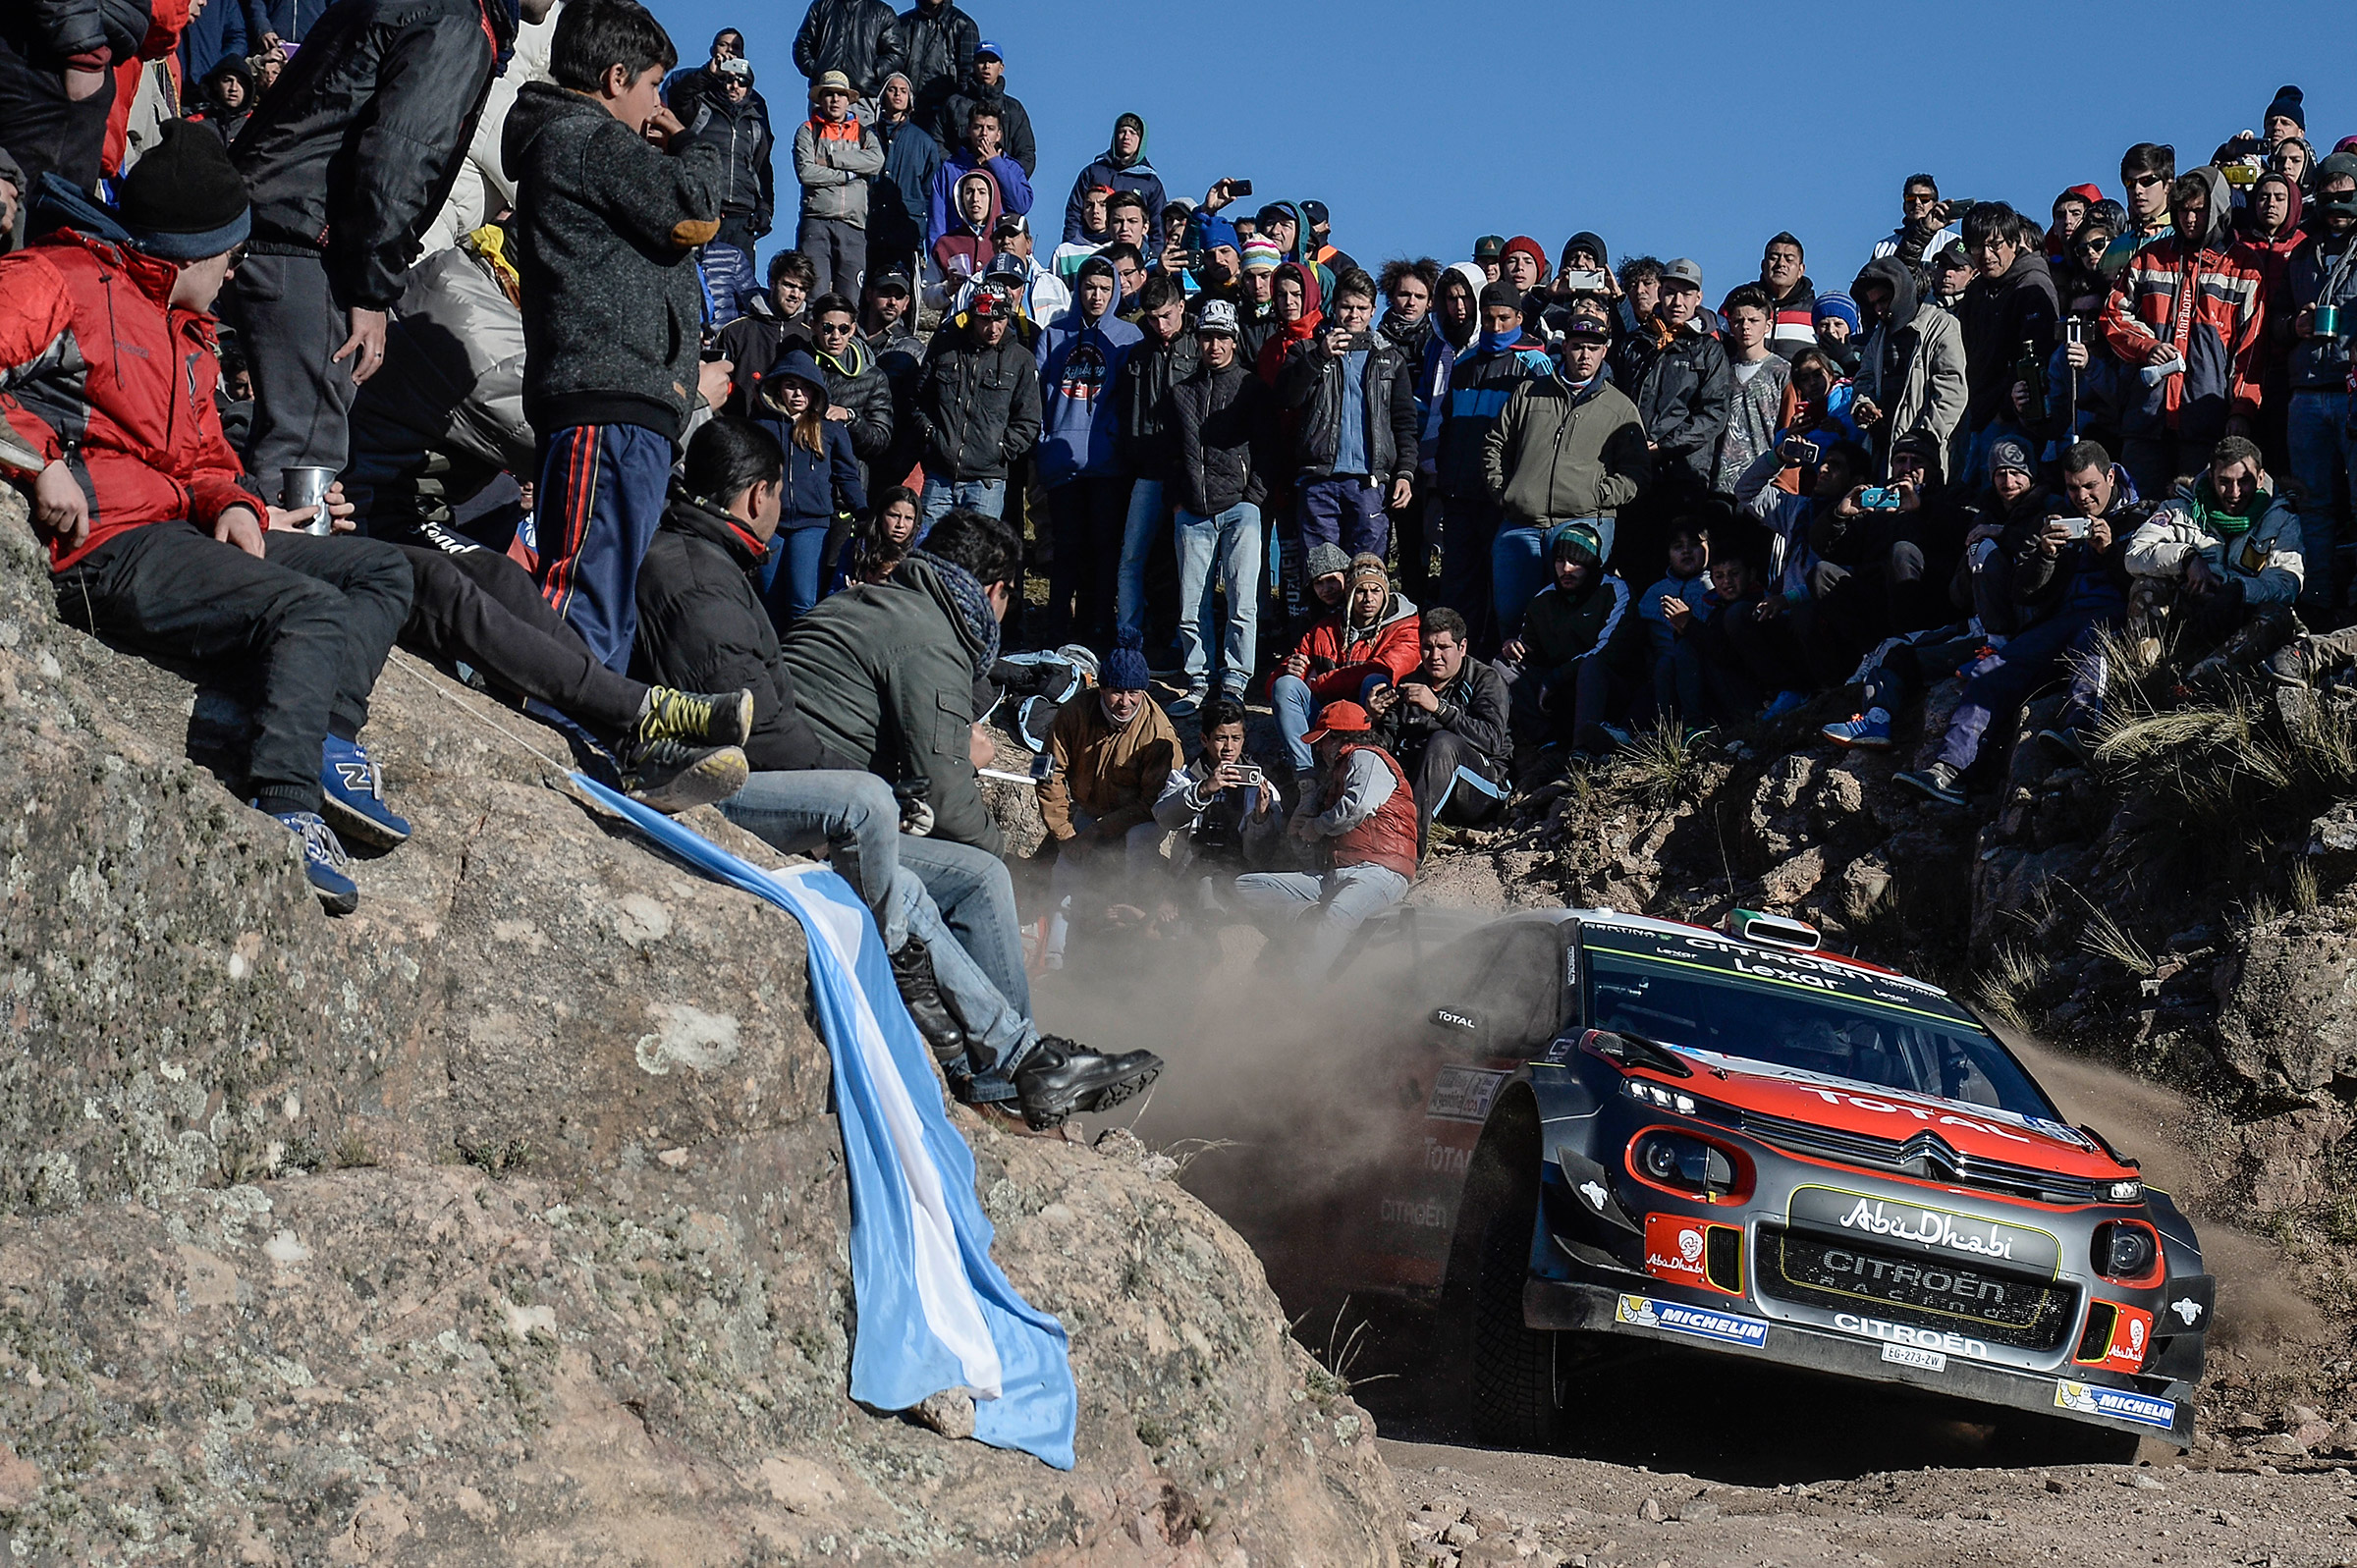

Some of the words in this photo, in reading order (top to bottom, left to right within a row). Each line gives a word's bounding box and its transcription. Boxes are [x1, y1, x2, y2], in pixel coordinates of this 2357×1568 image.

[2175, 289, 2192, 341] Marlboro
[1656, 946, 1699, 959] Lexar
[1685, 937, 1873, 983] CITROËN
[1733, 957, 1839, 990] Lexar
[1438, 1010, 1475, 1028] TOTAL
[1799, 1086, 2031, 1144] TOTAL
[1839, 1198, 1916, 1240] Abu
[1914, 1210, 2013, 1260] Dhabi
[1647, 1253, 1671, 1267] Abu
[1670, 1257, 1705, 1274] Dhabi
[1823, 1250, 2005, 1303] CITROËN
[1661, 1308, 1765, 1339] MICHELIN
[1834, 1313, 1989, 1358] CITROËN
[1888, 1348, 1941, 1367] EG-273-ZW
[2099, 1393, 2173, 1421] MICHELIN
